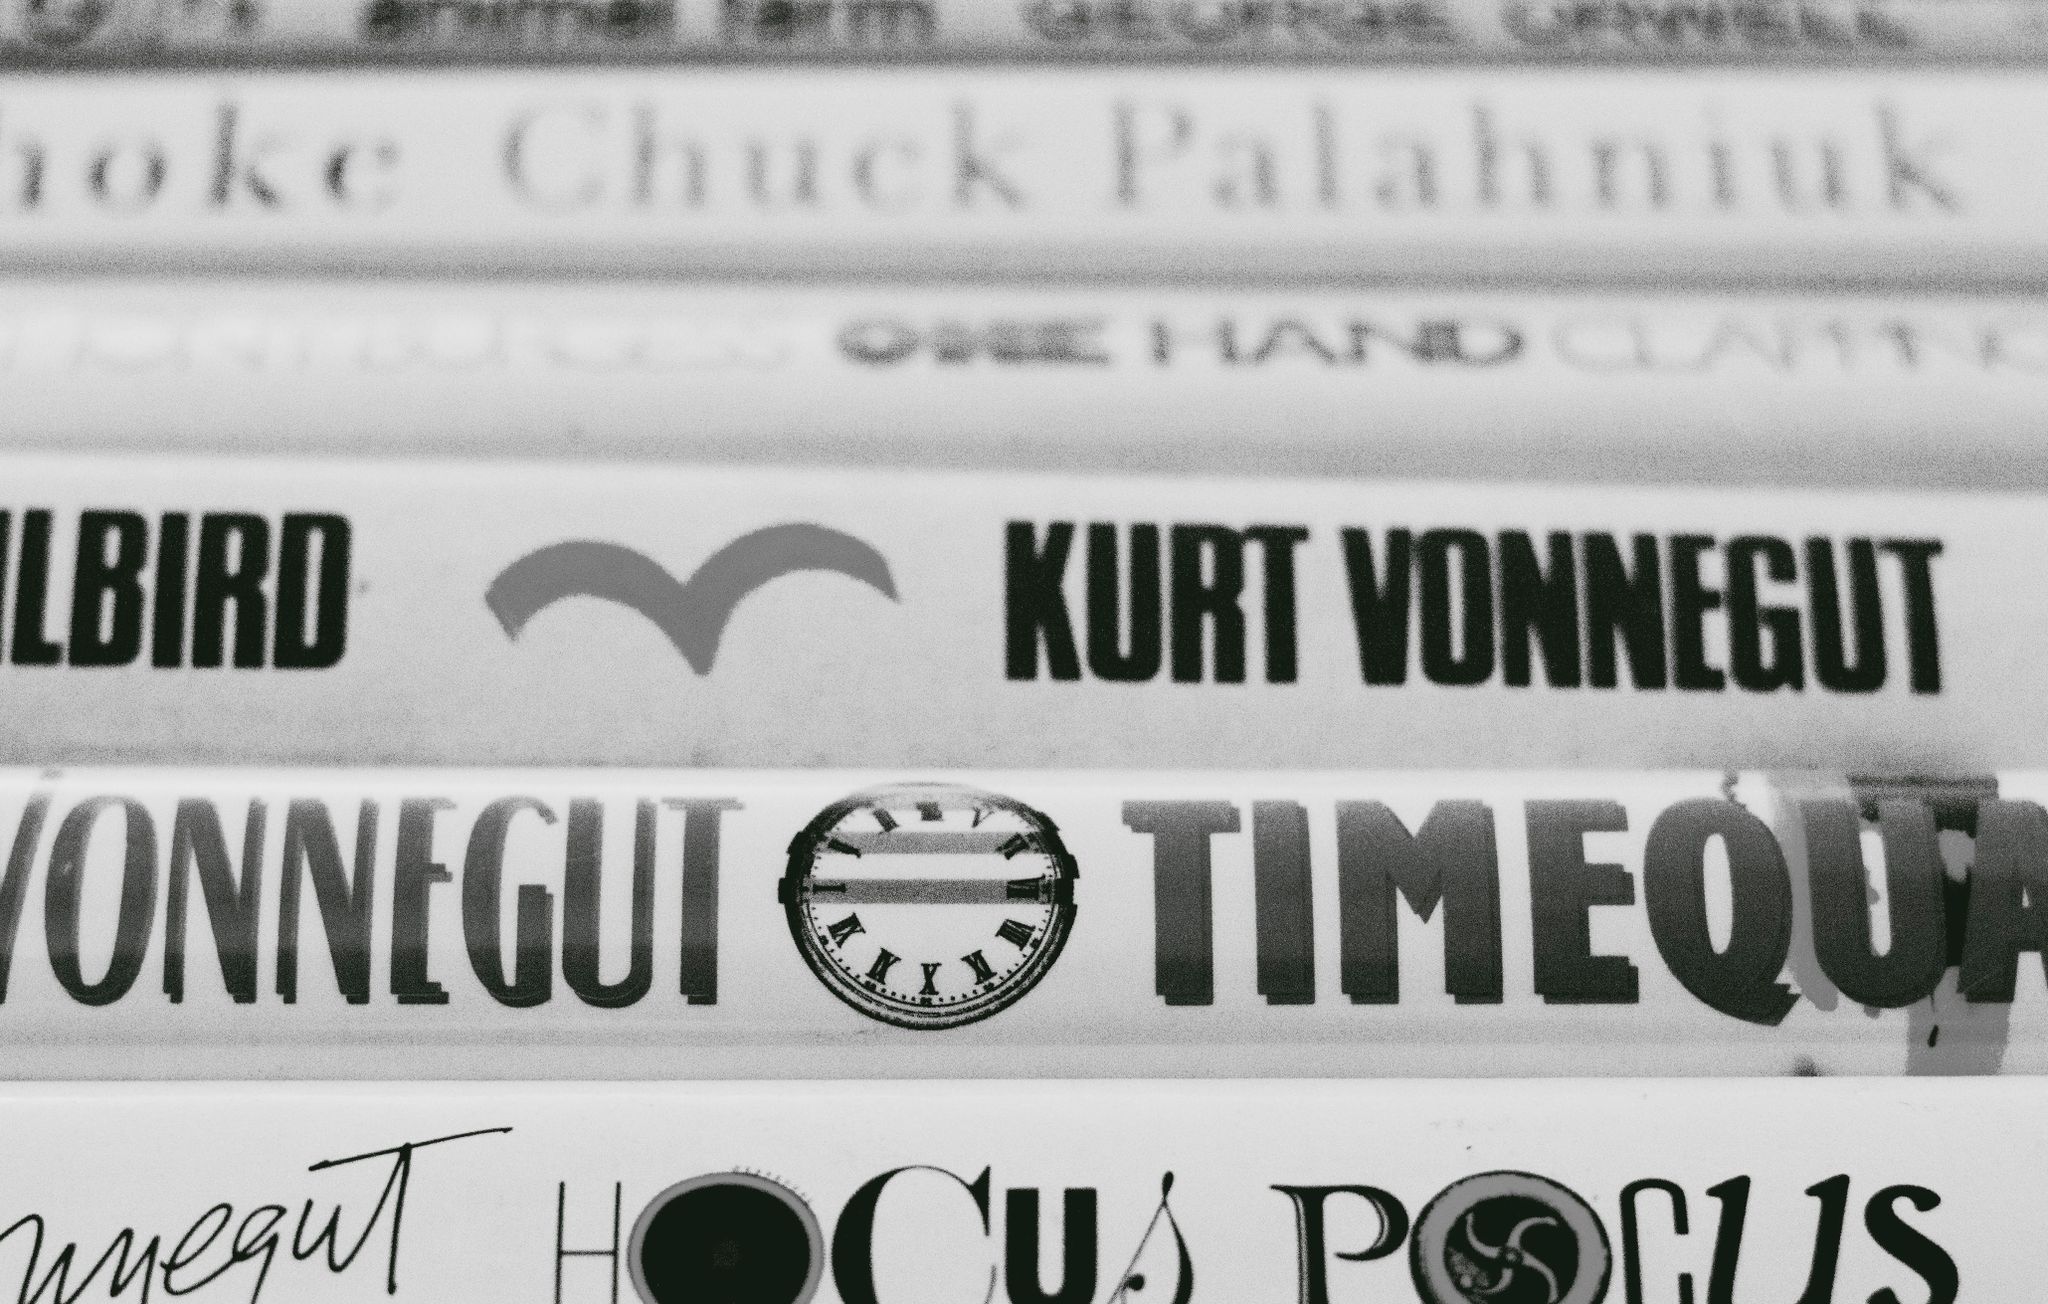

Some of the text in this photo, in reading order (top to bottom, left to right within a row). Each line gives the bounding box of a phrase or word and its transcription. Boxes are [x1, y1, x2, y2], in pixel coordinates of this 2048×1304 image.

[502, 98, 1028, 212] Chuck
[1110, 98, 1966, 214] Palahniuk
[1150, 318, 1528, 368] HAND
[1003, 519, 1946, 694] KURT VONNEGUT
